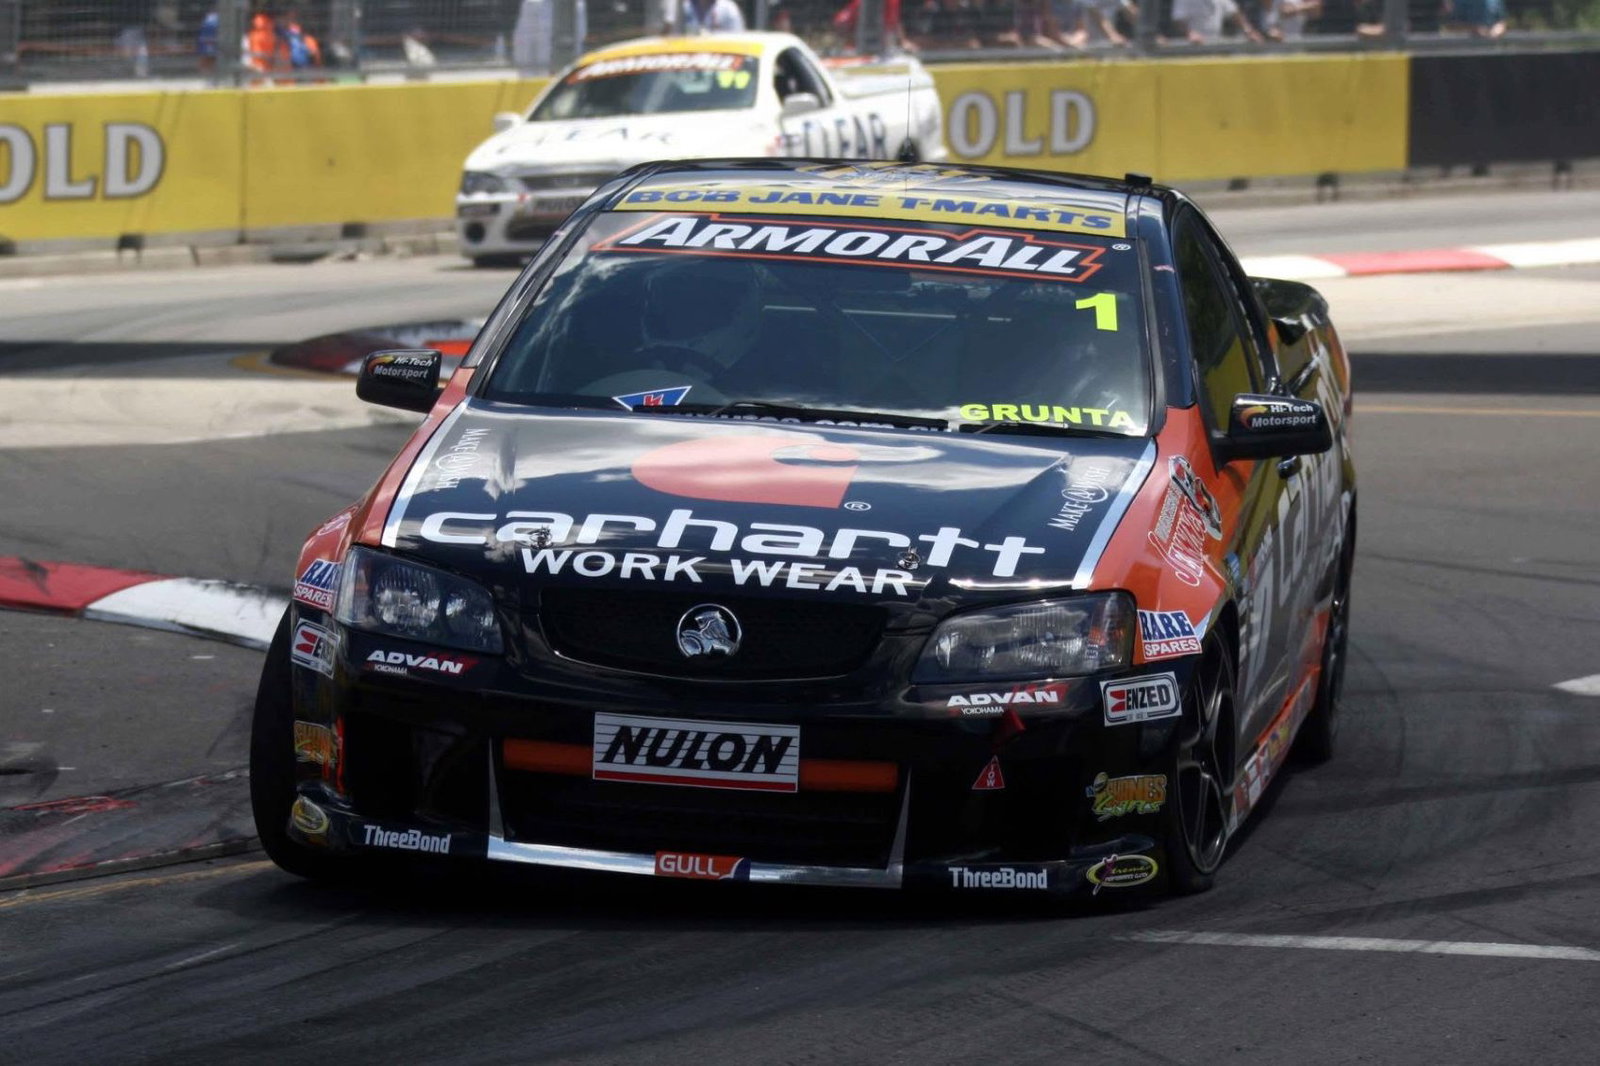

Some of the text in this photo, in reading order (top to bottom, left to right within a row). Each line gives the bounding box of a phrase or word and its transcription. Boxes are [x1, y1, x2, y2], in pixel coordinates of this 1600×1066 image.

[0, 122, 167, 203] OLD
[625, 189, 1112, 230] BOB JANE T-MARTS
[1075, 292, 1118, 331] 1
[373, 365, 429, 379] Motorsport
[393, 356, 433, 367] Hi-Tech
[959, 403, 1137, 428] GRUNTA
[1251, 414, 1317, 428] Motorsport
[1270, 404, 1314, 413] Hi-Tech
[419, 508, 1046, 577] carhartt
[521, 548, 914, 596] WORK WEAR
[294, 584, 334, 606] SPARES
[1138, 610, 1195, 641] RARE
[1144, 638, 1199, 657] SPARES
[366, 649, 464, 674] ADVAN
[946, 690, 1059, 707] ADVAN
[1126, 683, 1171, 711] ENZED
[961, 705, 1005, 715] YOKOHAMA
[602, 725, 793, 774] NULON
[363, 824, 452, 855] ThreeBond
[658, 853, 720, 877] GULL
[948, 866, 1048, 889] ThreeBond
